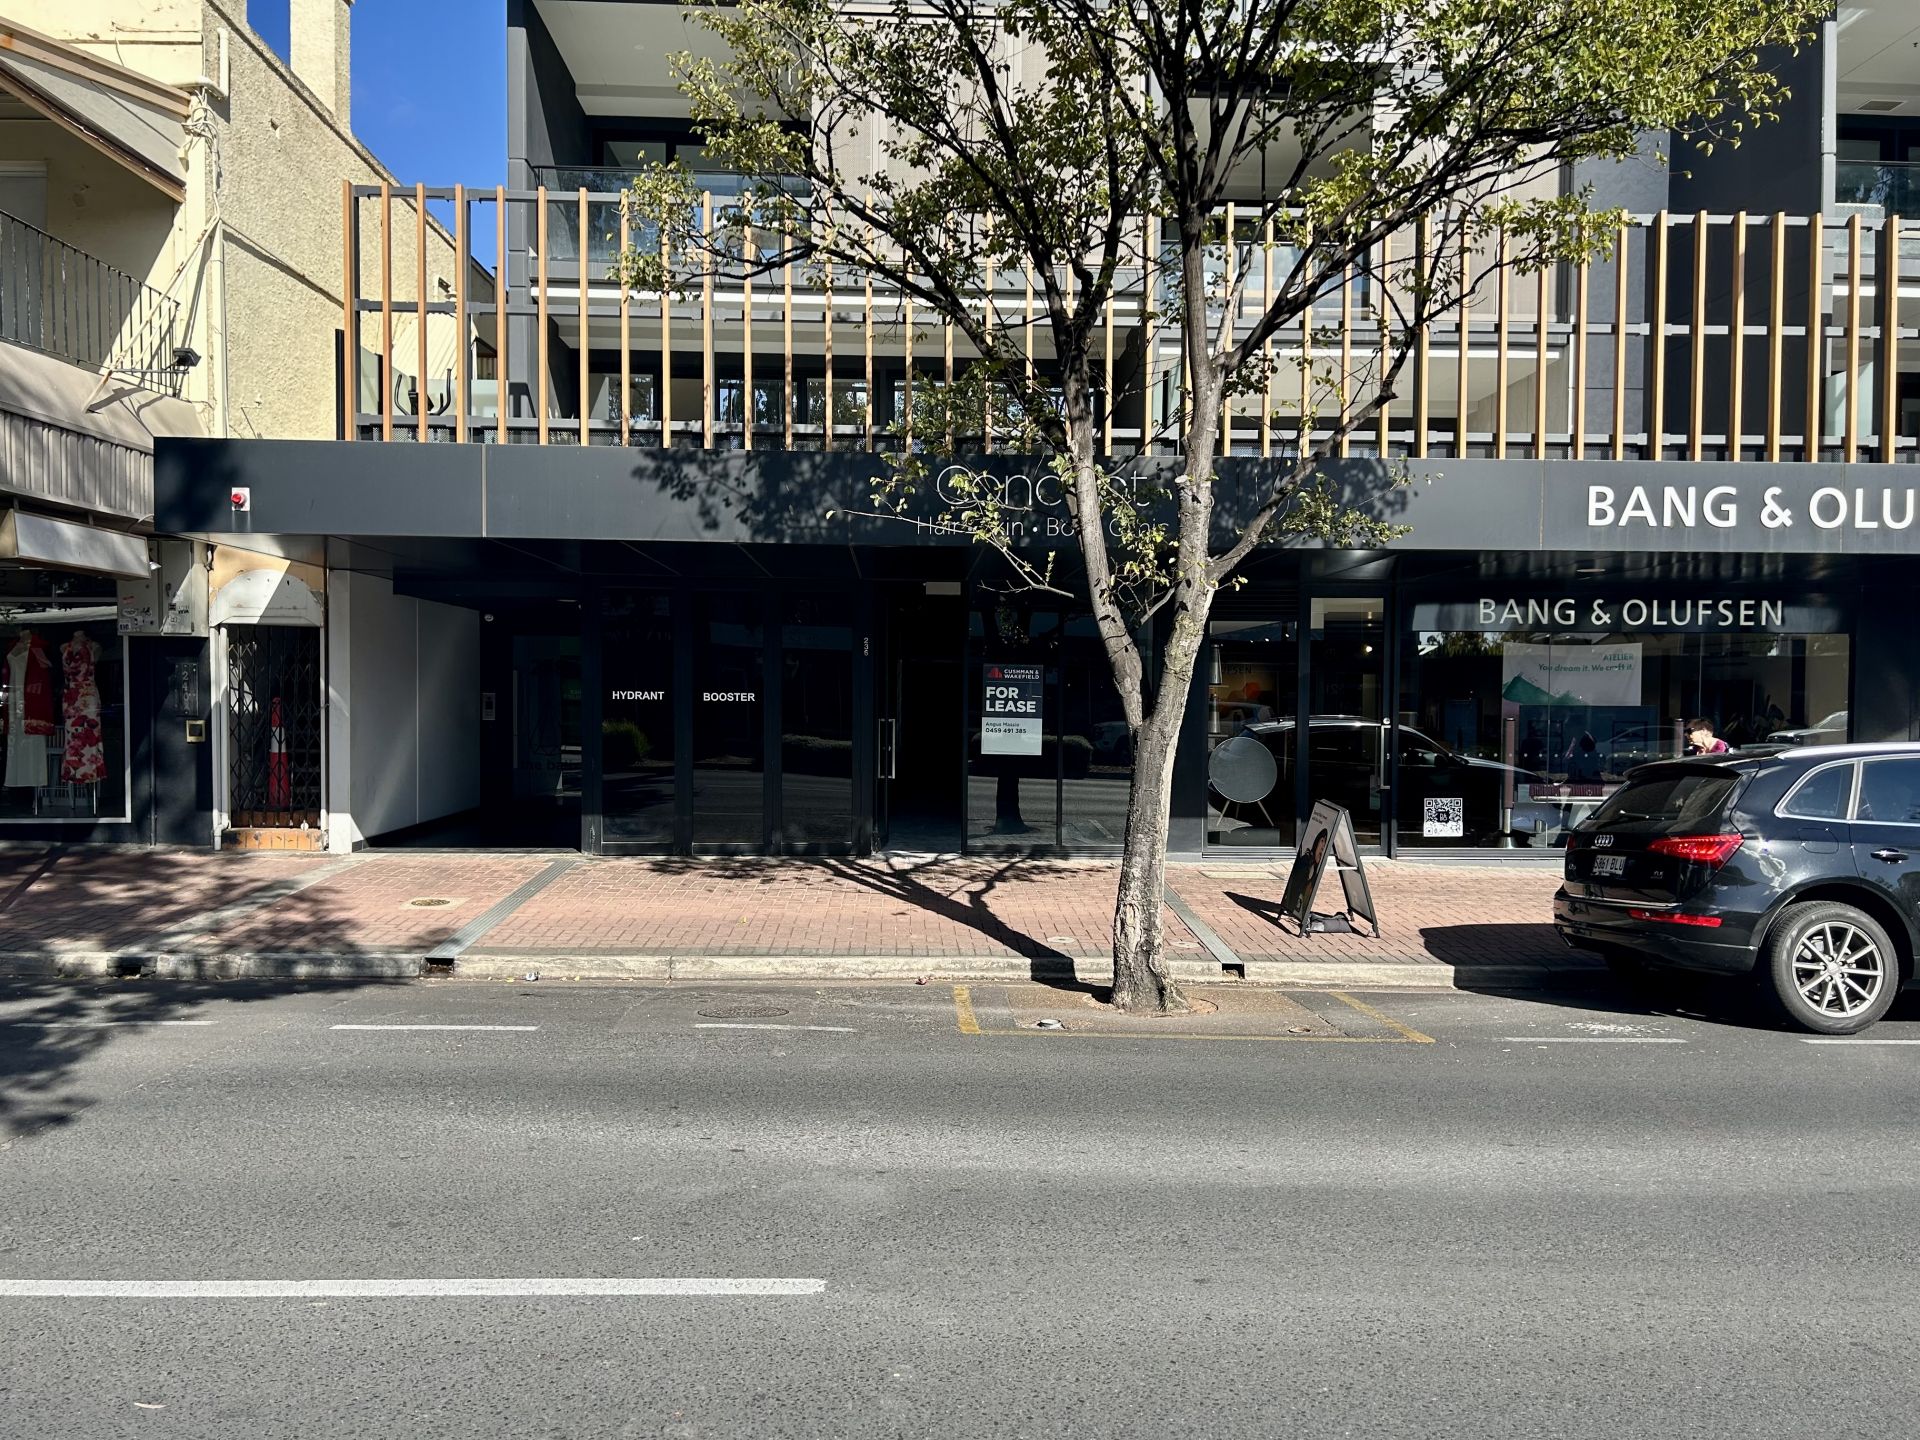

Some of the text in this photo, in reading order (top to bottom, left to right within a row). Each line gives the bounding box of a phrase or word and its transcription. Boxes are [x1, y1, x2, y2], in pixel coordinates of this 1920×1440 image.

[937, 465, 1150, 507] Conct
[1588, 486, 1915, 529] BANG & OLU
[1479, 598, 1783, 627] BANG & OLUFSEN
[1554, 664, 1581, 672] dream
[1592, 664, 1604, 672] We
[612, 691, 664, 700] HYDRANT
[703, 692, 755, 702] BOOSTER
[986, 686, 1018, 698] FOR
[986, 700, 1036, 712] LEASE
